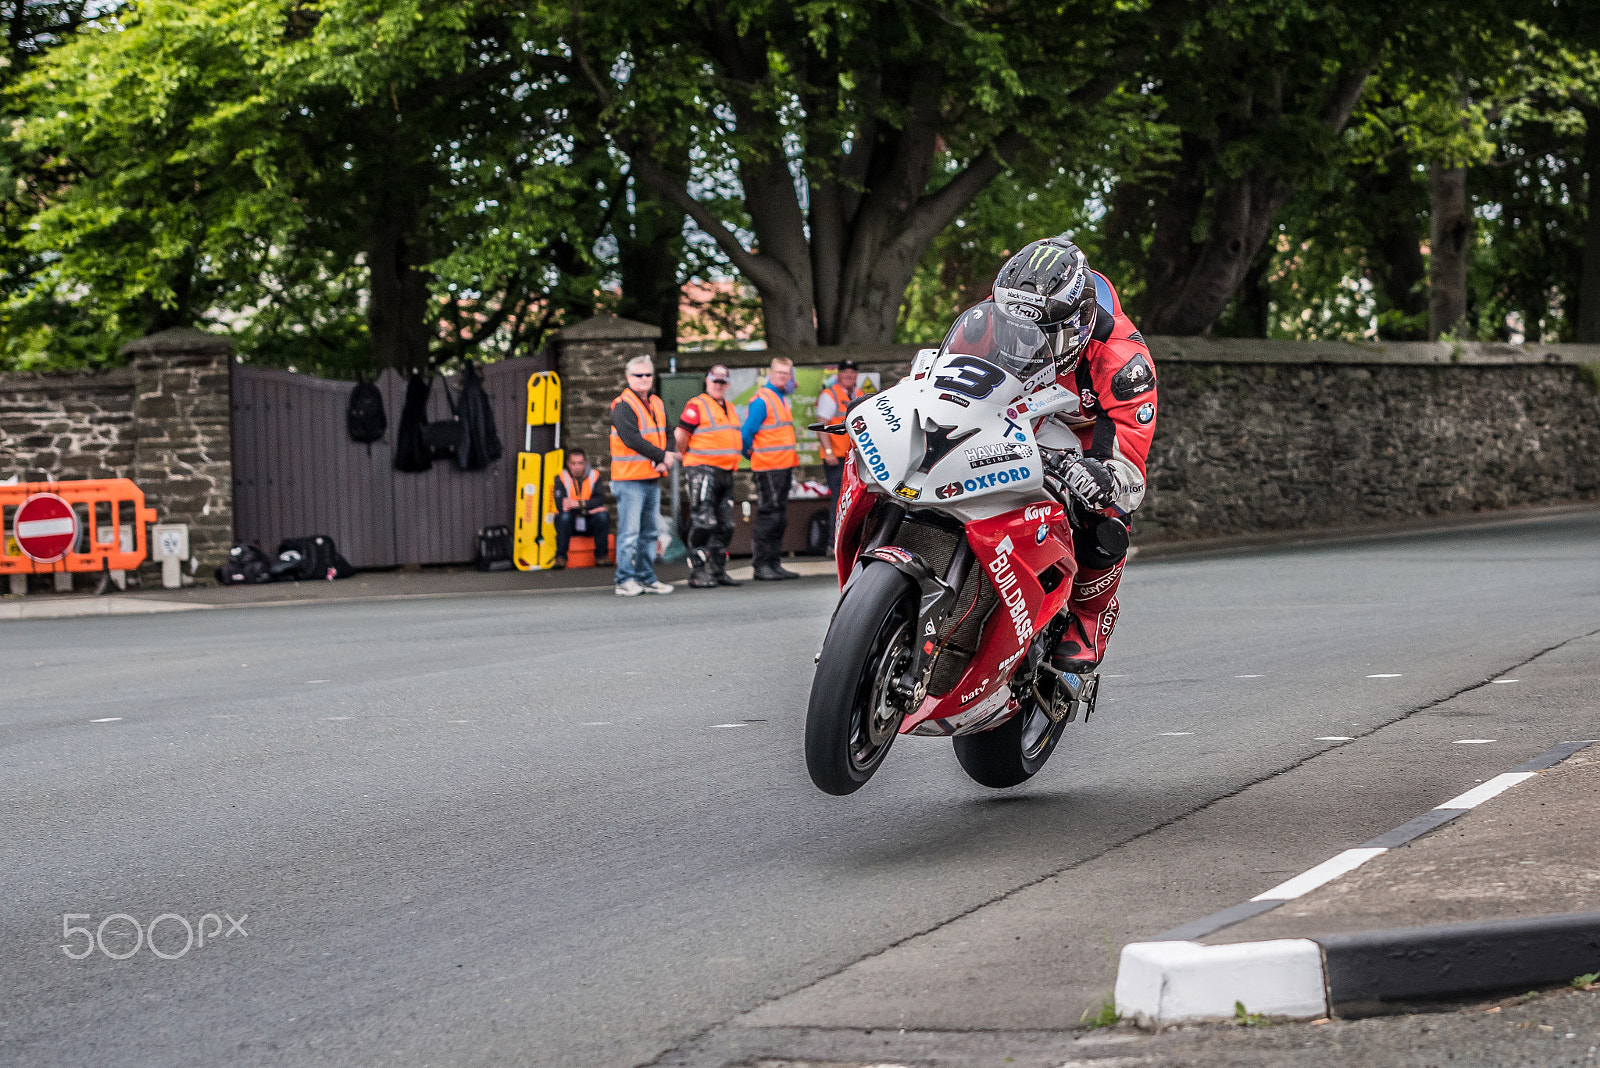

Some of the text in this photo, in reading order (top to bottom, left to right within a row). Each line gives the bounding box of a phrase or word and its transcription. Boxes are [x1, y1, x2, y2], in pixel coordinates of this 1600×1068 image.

[934, 356, 1006, 400] 3
[875, 396, 901, 433] Kubota
[858, 432, 890, 481] OXFORD
[965, 443, 1011, 462] HAWK
[971, 455, 1010, 468] RACING
[964, 466, 1031, 492] OXFORD
[1024, 505, 1052, 523] Koyo
[1080, 566, 1122, 596] daytona
[989, 554, 1033, 644] BUILDBASE
